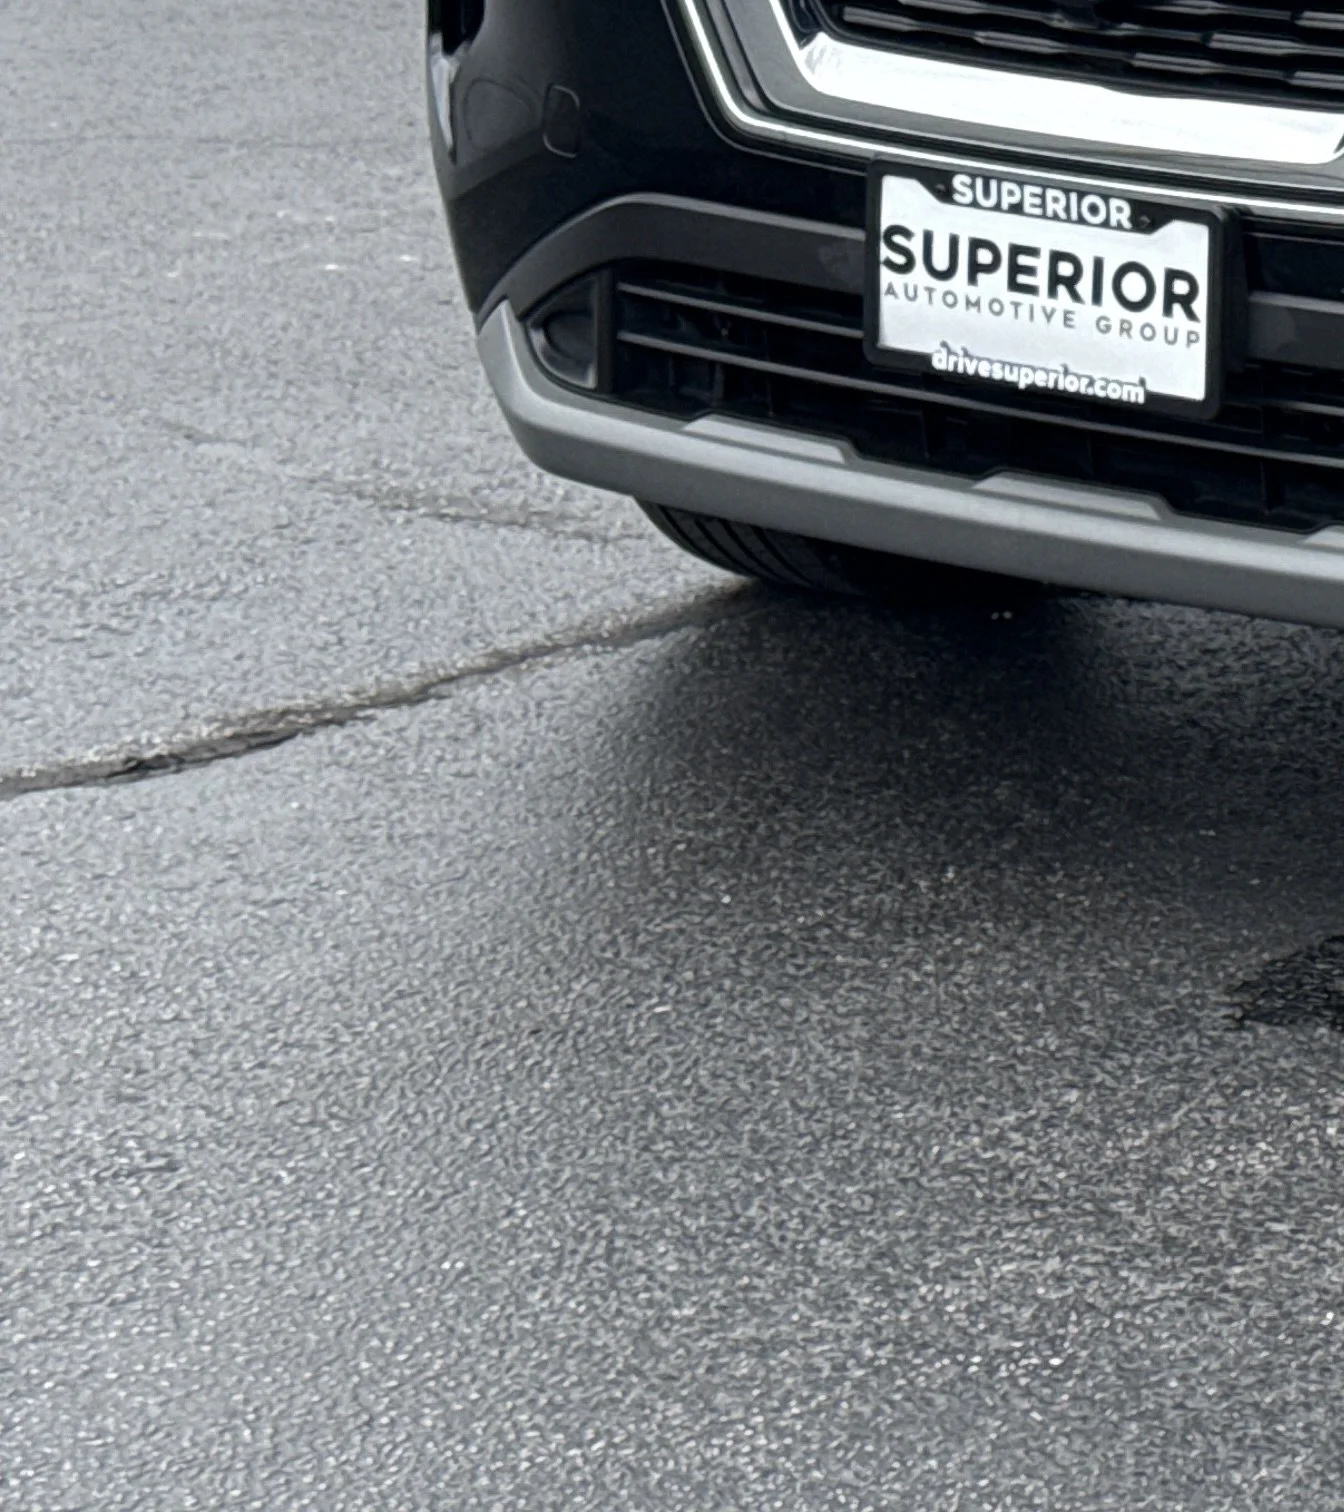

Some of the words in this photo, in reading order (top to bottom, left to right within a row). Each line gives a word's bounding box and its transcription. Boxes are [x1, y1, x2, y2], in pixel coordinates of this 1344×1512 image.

[951, 174, 1132, 230] SUPERIOR
[881, 224, 1201, 323] SUPERIOR
[884, 281, 1076, 330] AUTOMOTIVE
[1096, 316, 1201, 350] GROUP
[931, 341, 1146, 404] drivesuperior.com
